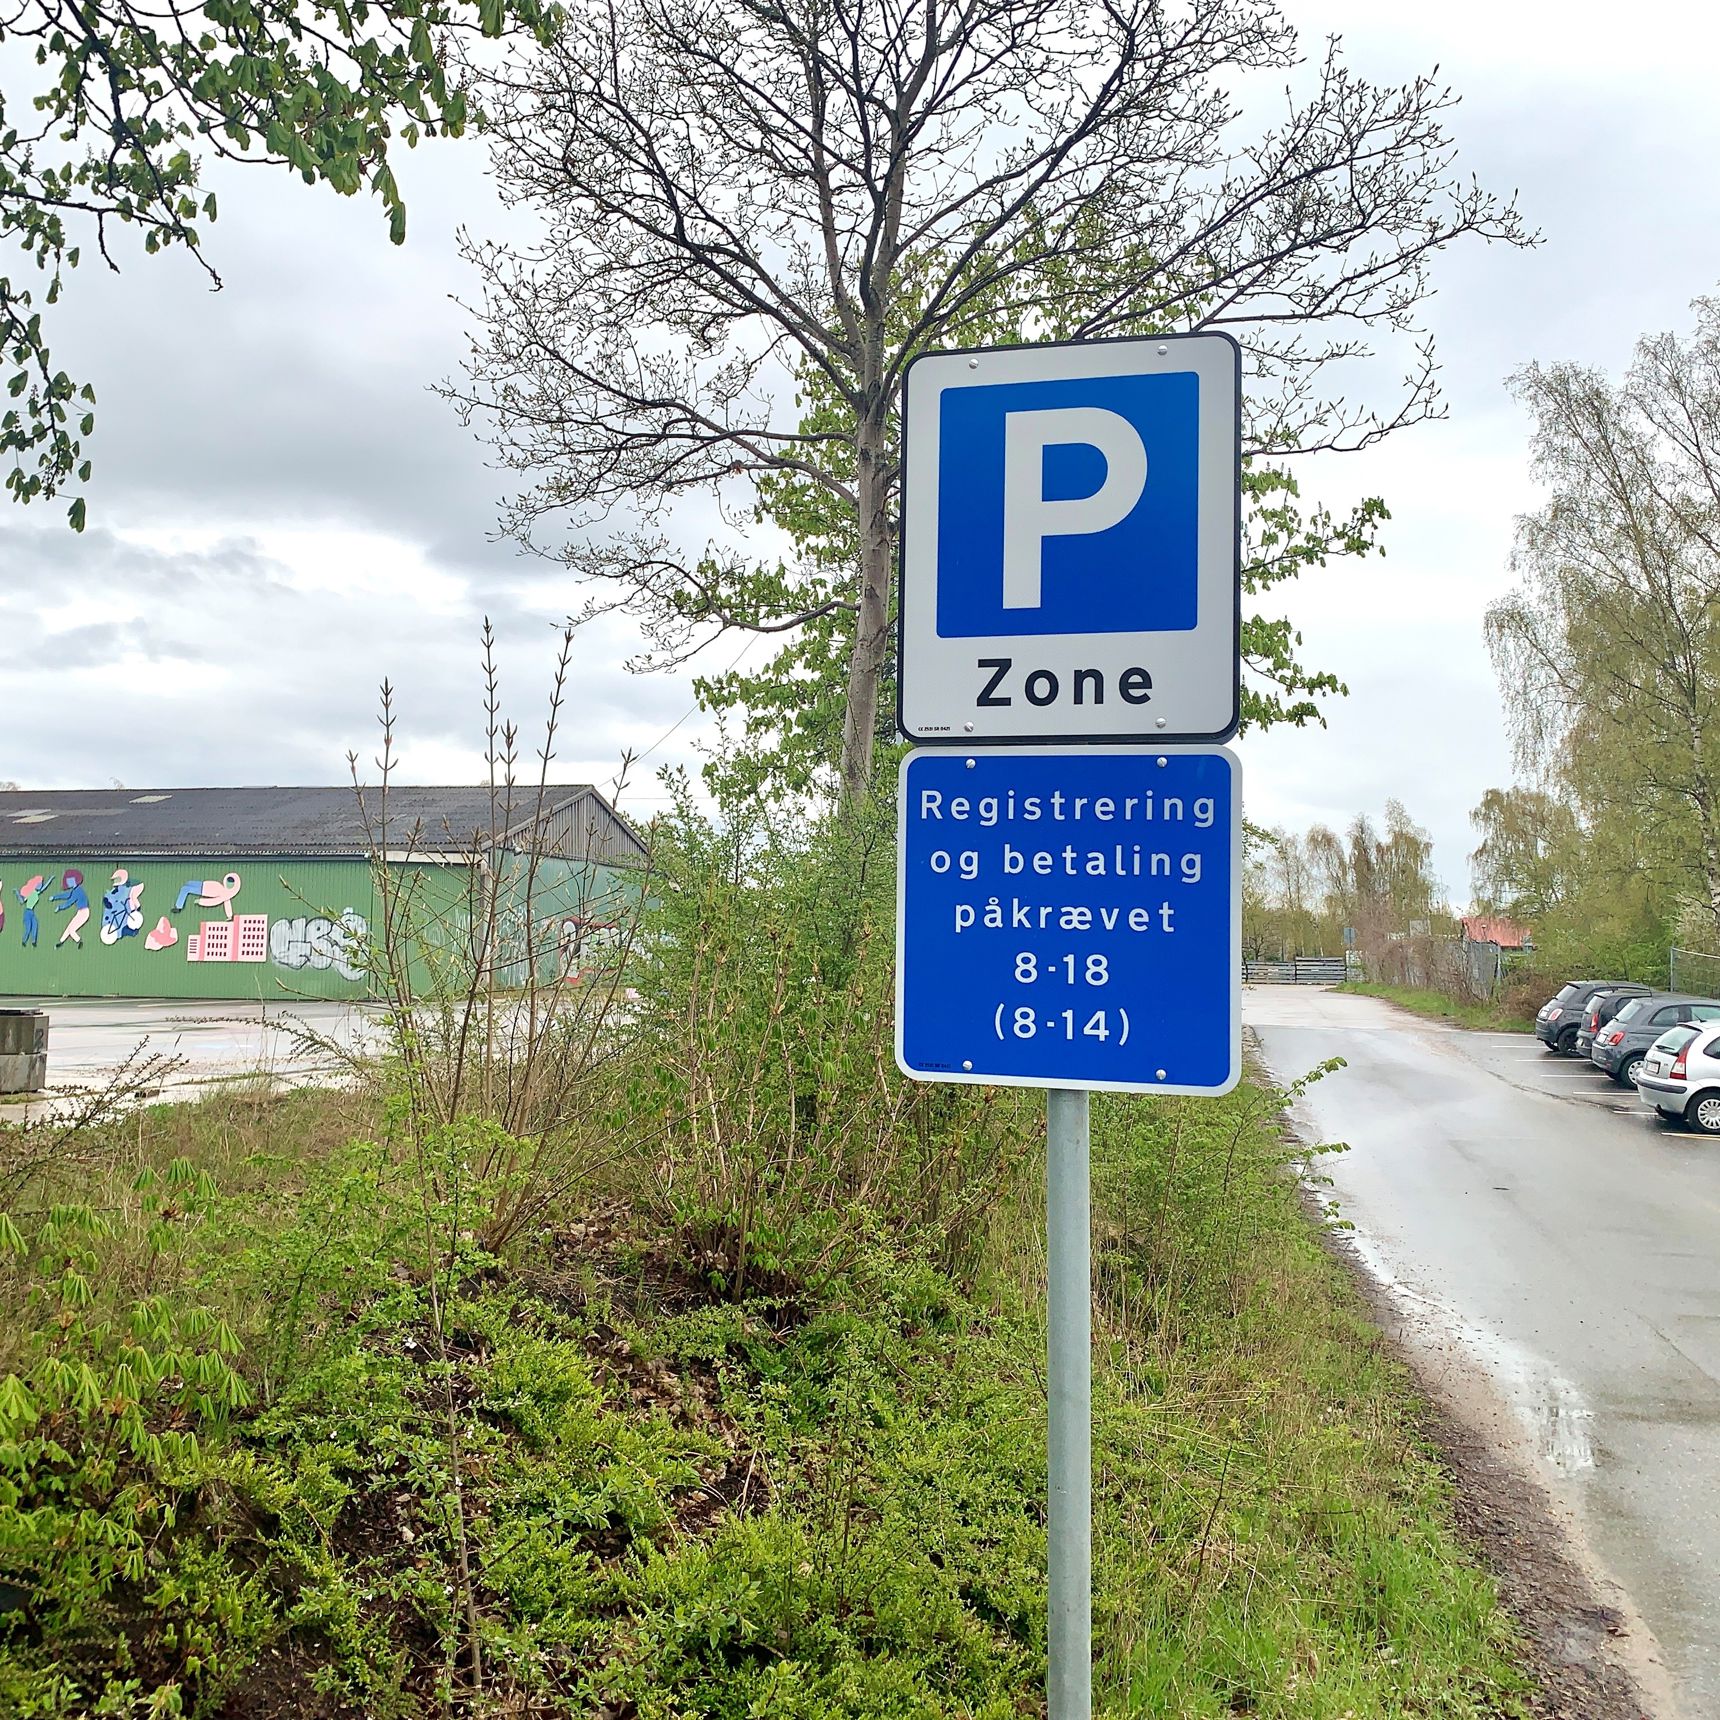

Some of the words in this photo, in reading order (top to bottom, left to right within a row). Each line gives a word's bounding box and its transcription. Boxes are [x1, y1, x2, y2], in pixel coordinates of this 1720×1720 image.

[1003, 407, 1148, 610] P
[976, 658, 1153, 707] Zone
[921, 790, 1215, 828] Registrering
[930, 850, 979, 880] og
[1004, 844, 1202, 884] betaling
[955, 897, 1175, 933] påkrævet
[1014, 952, 1109, 986] 8-18
